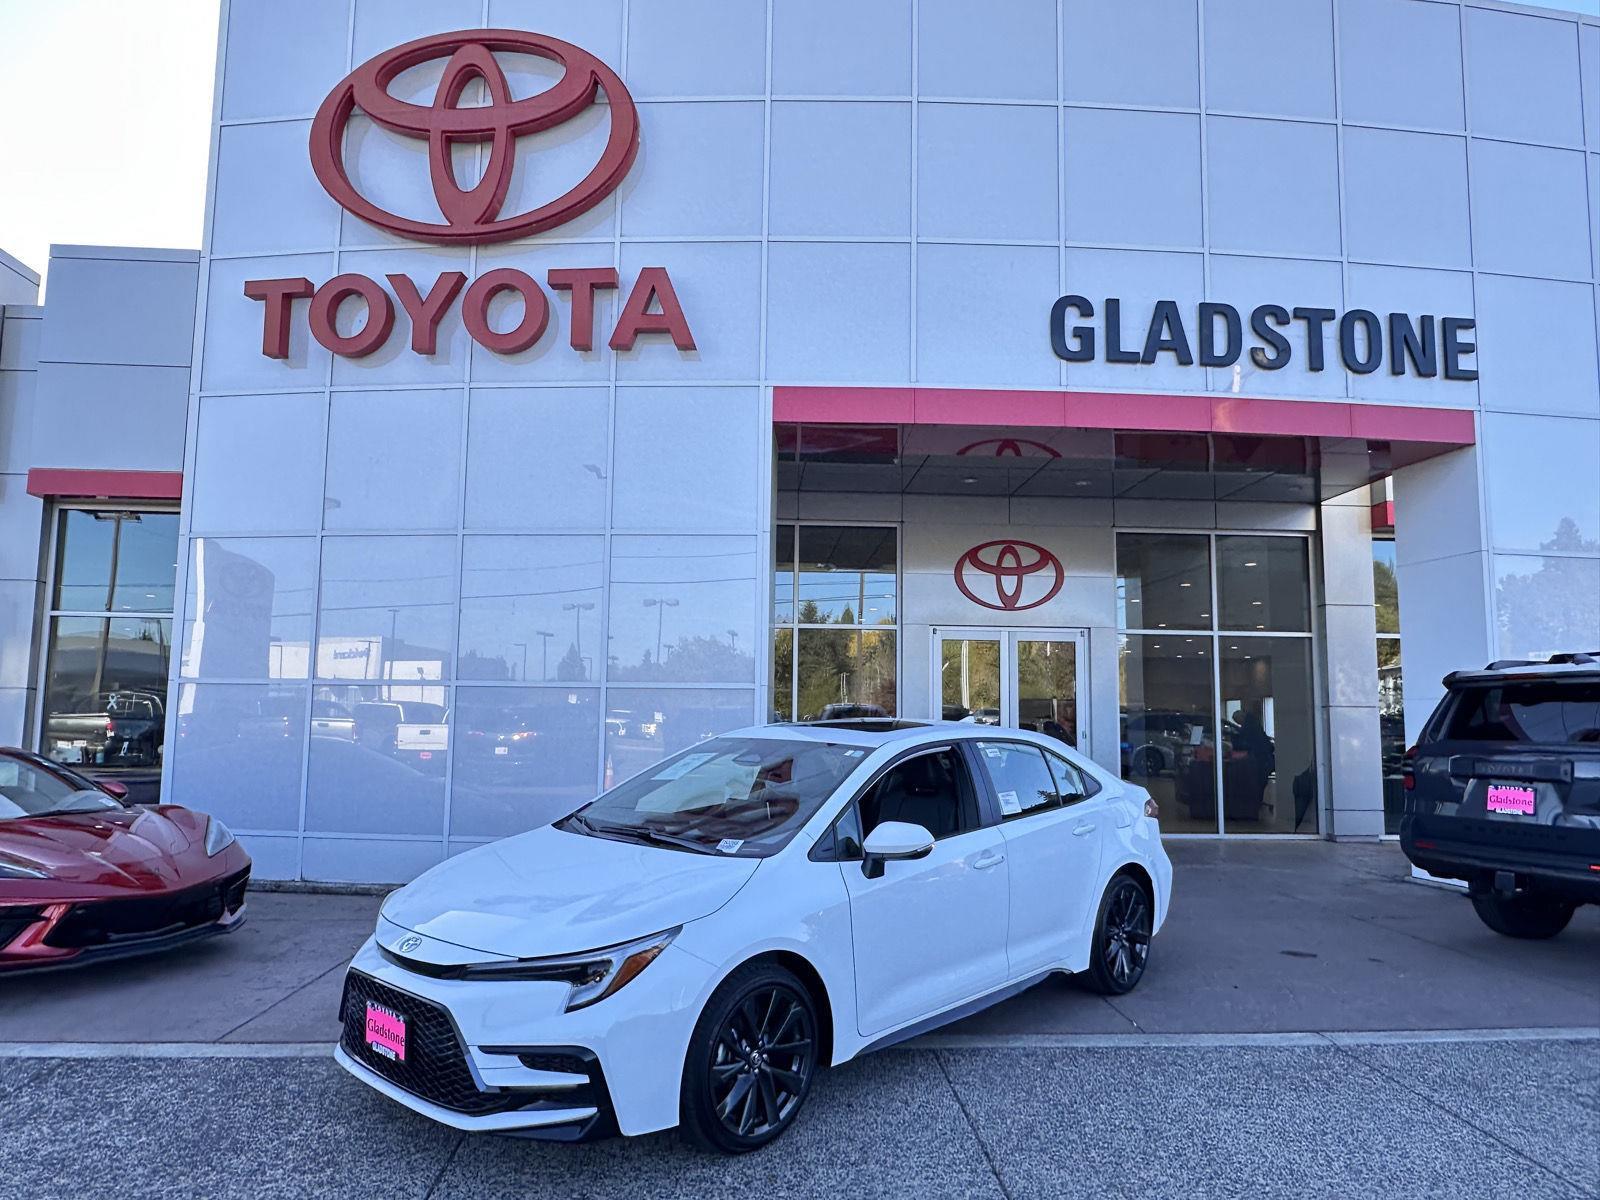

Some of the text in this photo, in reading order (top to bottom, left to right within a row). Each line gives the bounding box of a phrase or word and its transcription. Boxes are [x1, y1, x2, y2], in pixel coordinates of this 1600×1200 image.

[244, 267, 697, 359] TOYOTA
[1050, 295, 1479, 380] GLADSTONE
[1489, 794, 1533, 806] Gladstone
[367, 1018, 405, 1047] Gladstone
